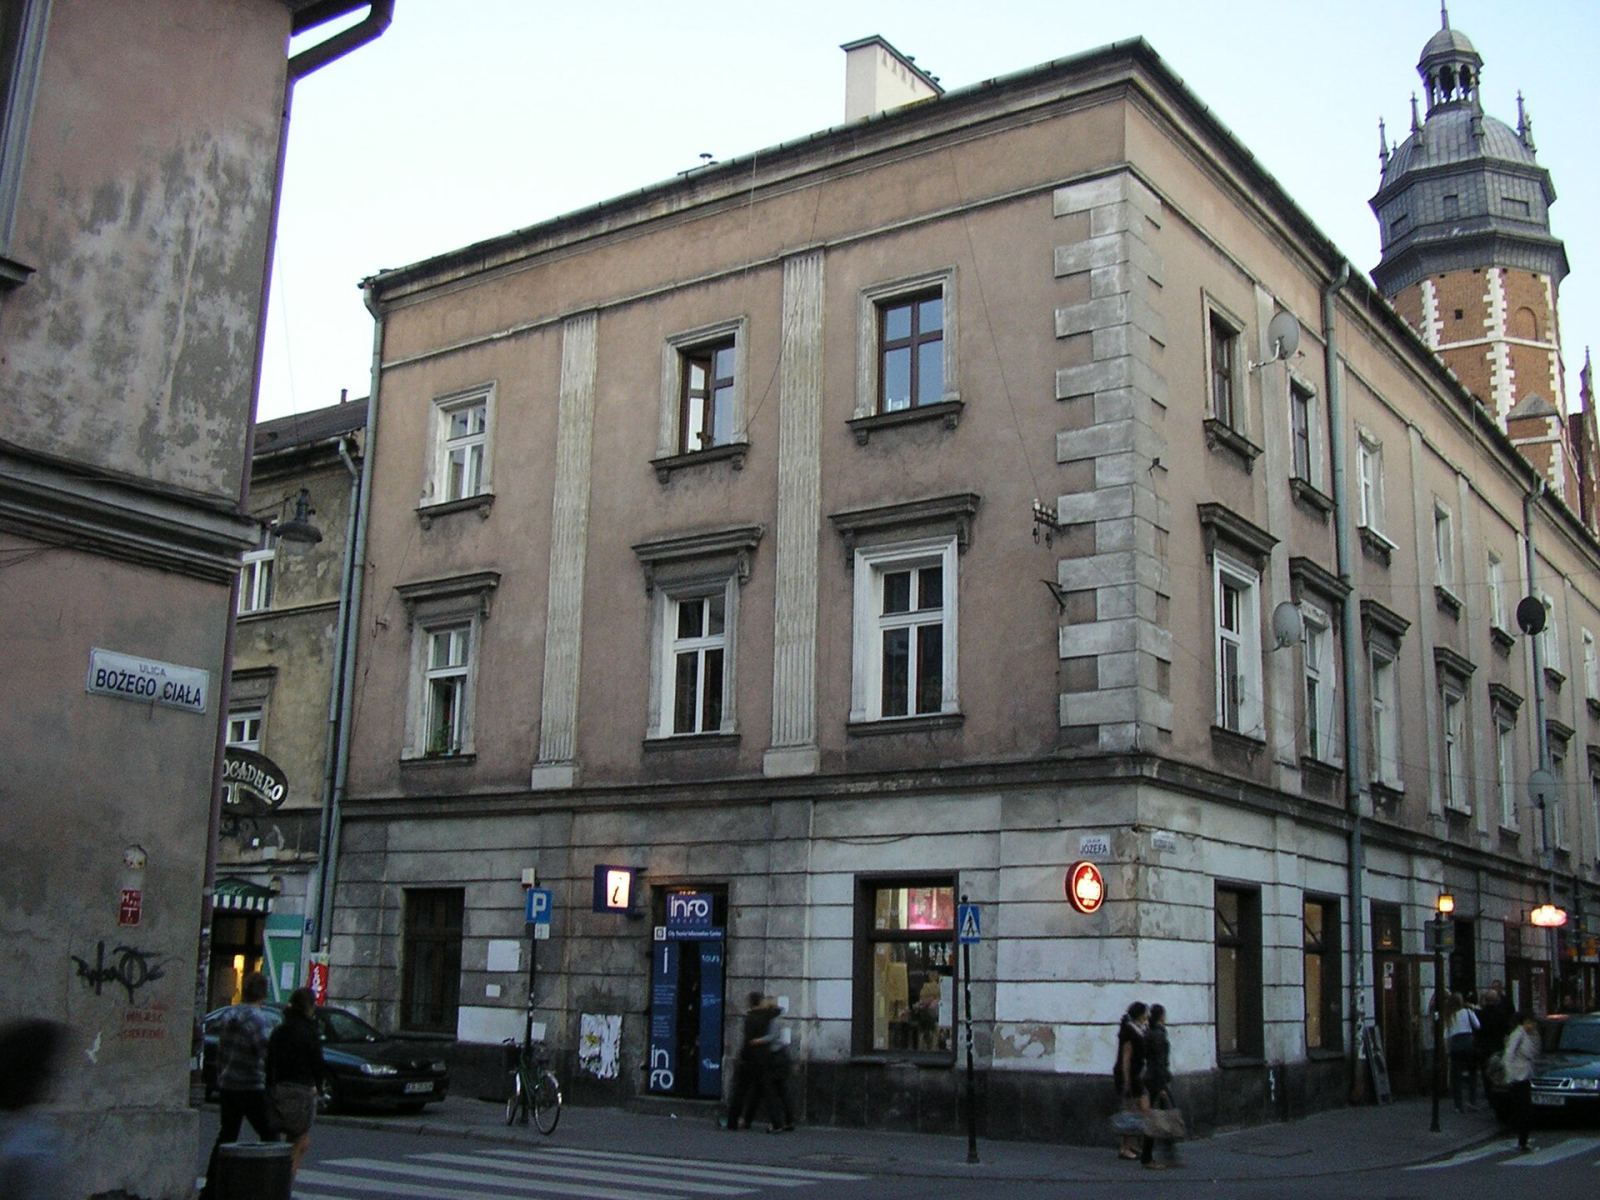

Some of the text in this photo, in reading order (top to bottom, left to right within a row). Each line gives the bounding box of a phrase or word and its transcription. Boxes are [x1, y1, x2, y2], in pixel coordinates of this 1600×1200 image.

[139, 664, 167, 677] ULICA
[95, 668, 201, 706] BOŻEGO CIAŁA
[532, 892, 547, 918] P
